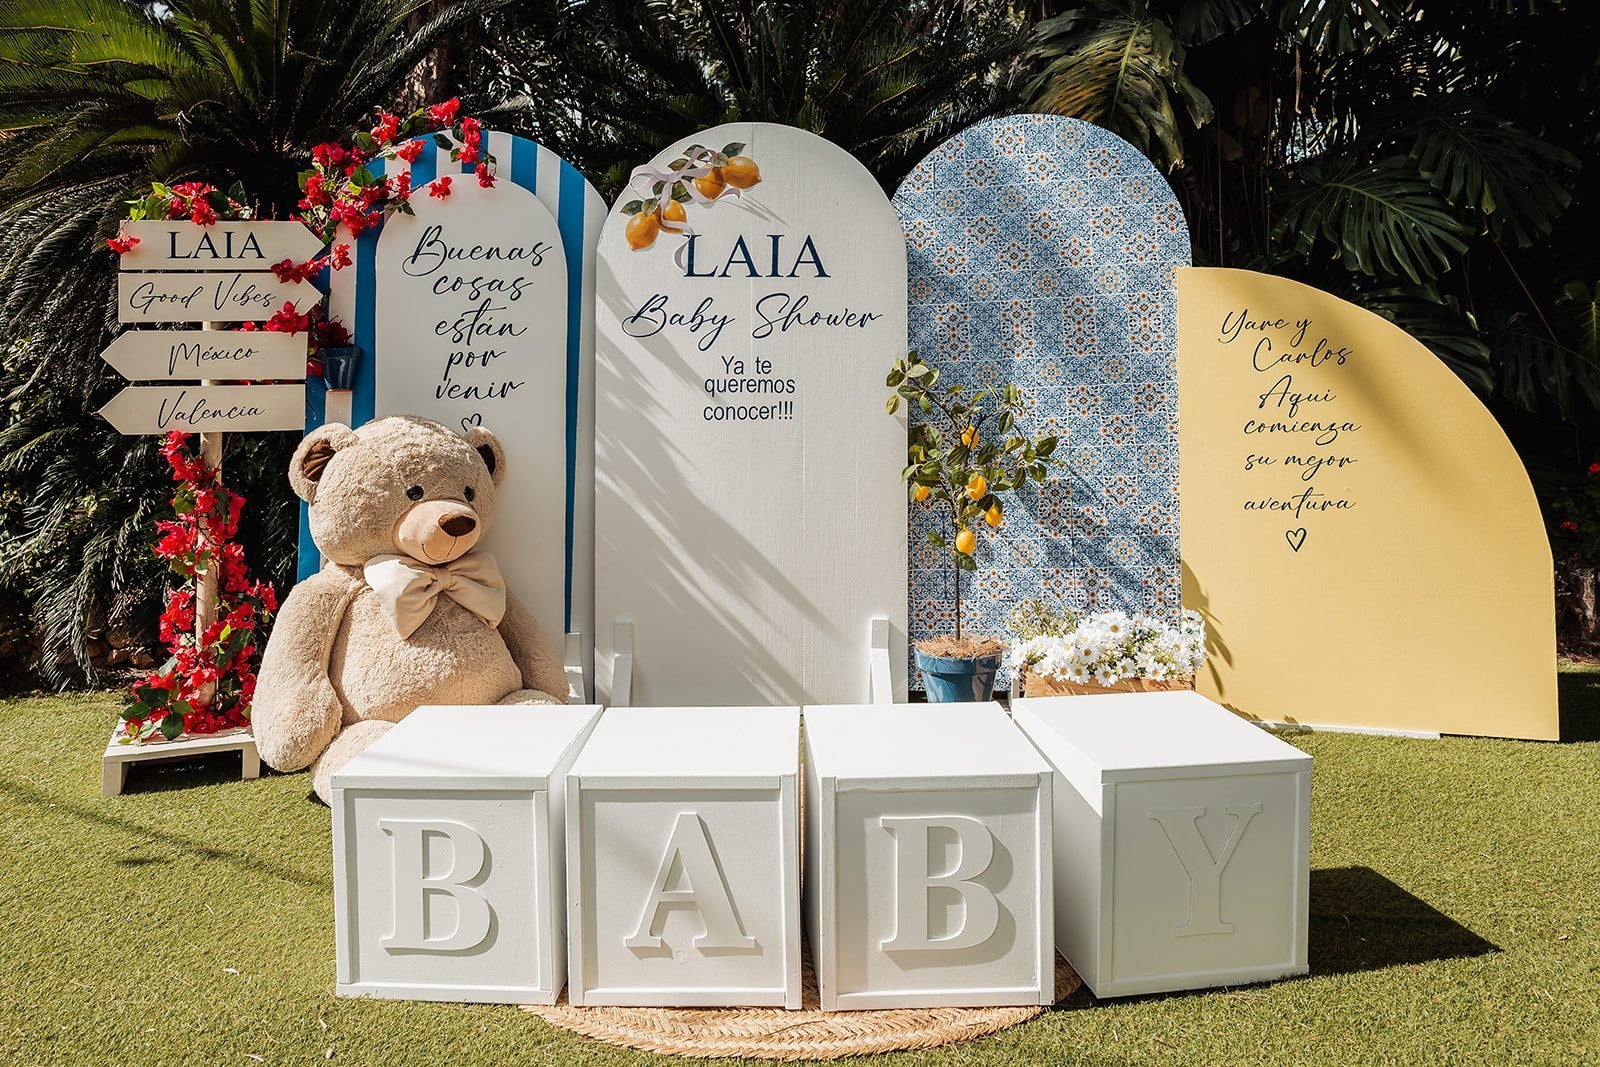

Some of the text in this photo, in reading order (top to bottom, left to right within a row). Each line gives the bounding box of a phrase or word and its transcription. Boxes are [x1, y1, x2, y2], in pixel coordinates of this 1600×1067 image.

[167, 231, 266, 259] LAIA
[402, 224, 552, 276] Buenas
[683, 234, 831, 278] LAIA
[129, 273, 277, 314] Good Vibes
[432, 275, 533, 301] cosas
[434, 297, 528, 346] están
[621, 293, 883, 352] Baby Shower
[1217, 308, 1312, 347] Yare y
[168, 342, 259, 376] México
[443, 349, 507, 382] por
[721, 355, 773, 375] Ya te
[1252, 336, 1353, 372] Carlos
[435, 377, 526, 401] venir
[704, 376, 796, 398] queremos
[158, 390, 266, 429] Valencia
[703, 401, 794, 421] conocer!!!
[1243, 418, 1362, 446] comienza
[1244, 453, 1358, 482] su mejor
[1243, 486, 1356, 519] aventura
